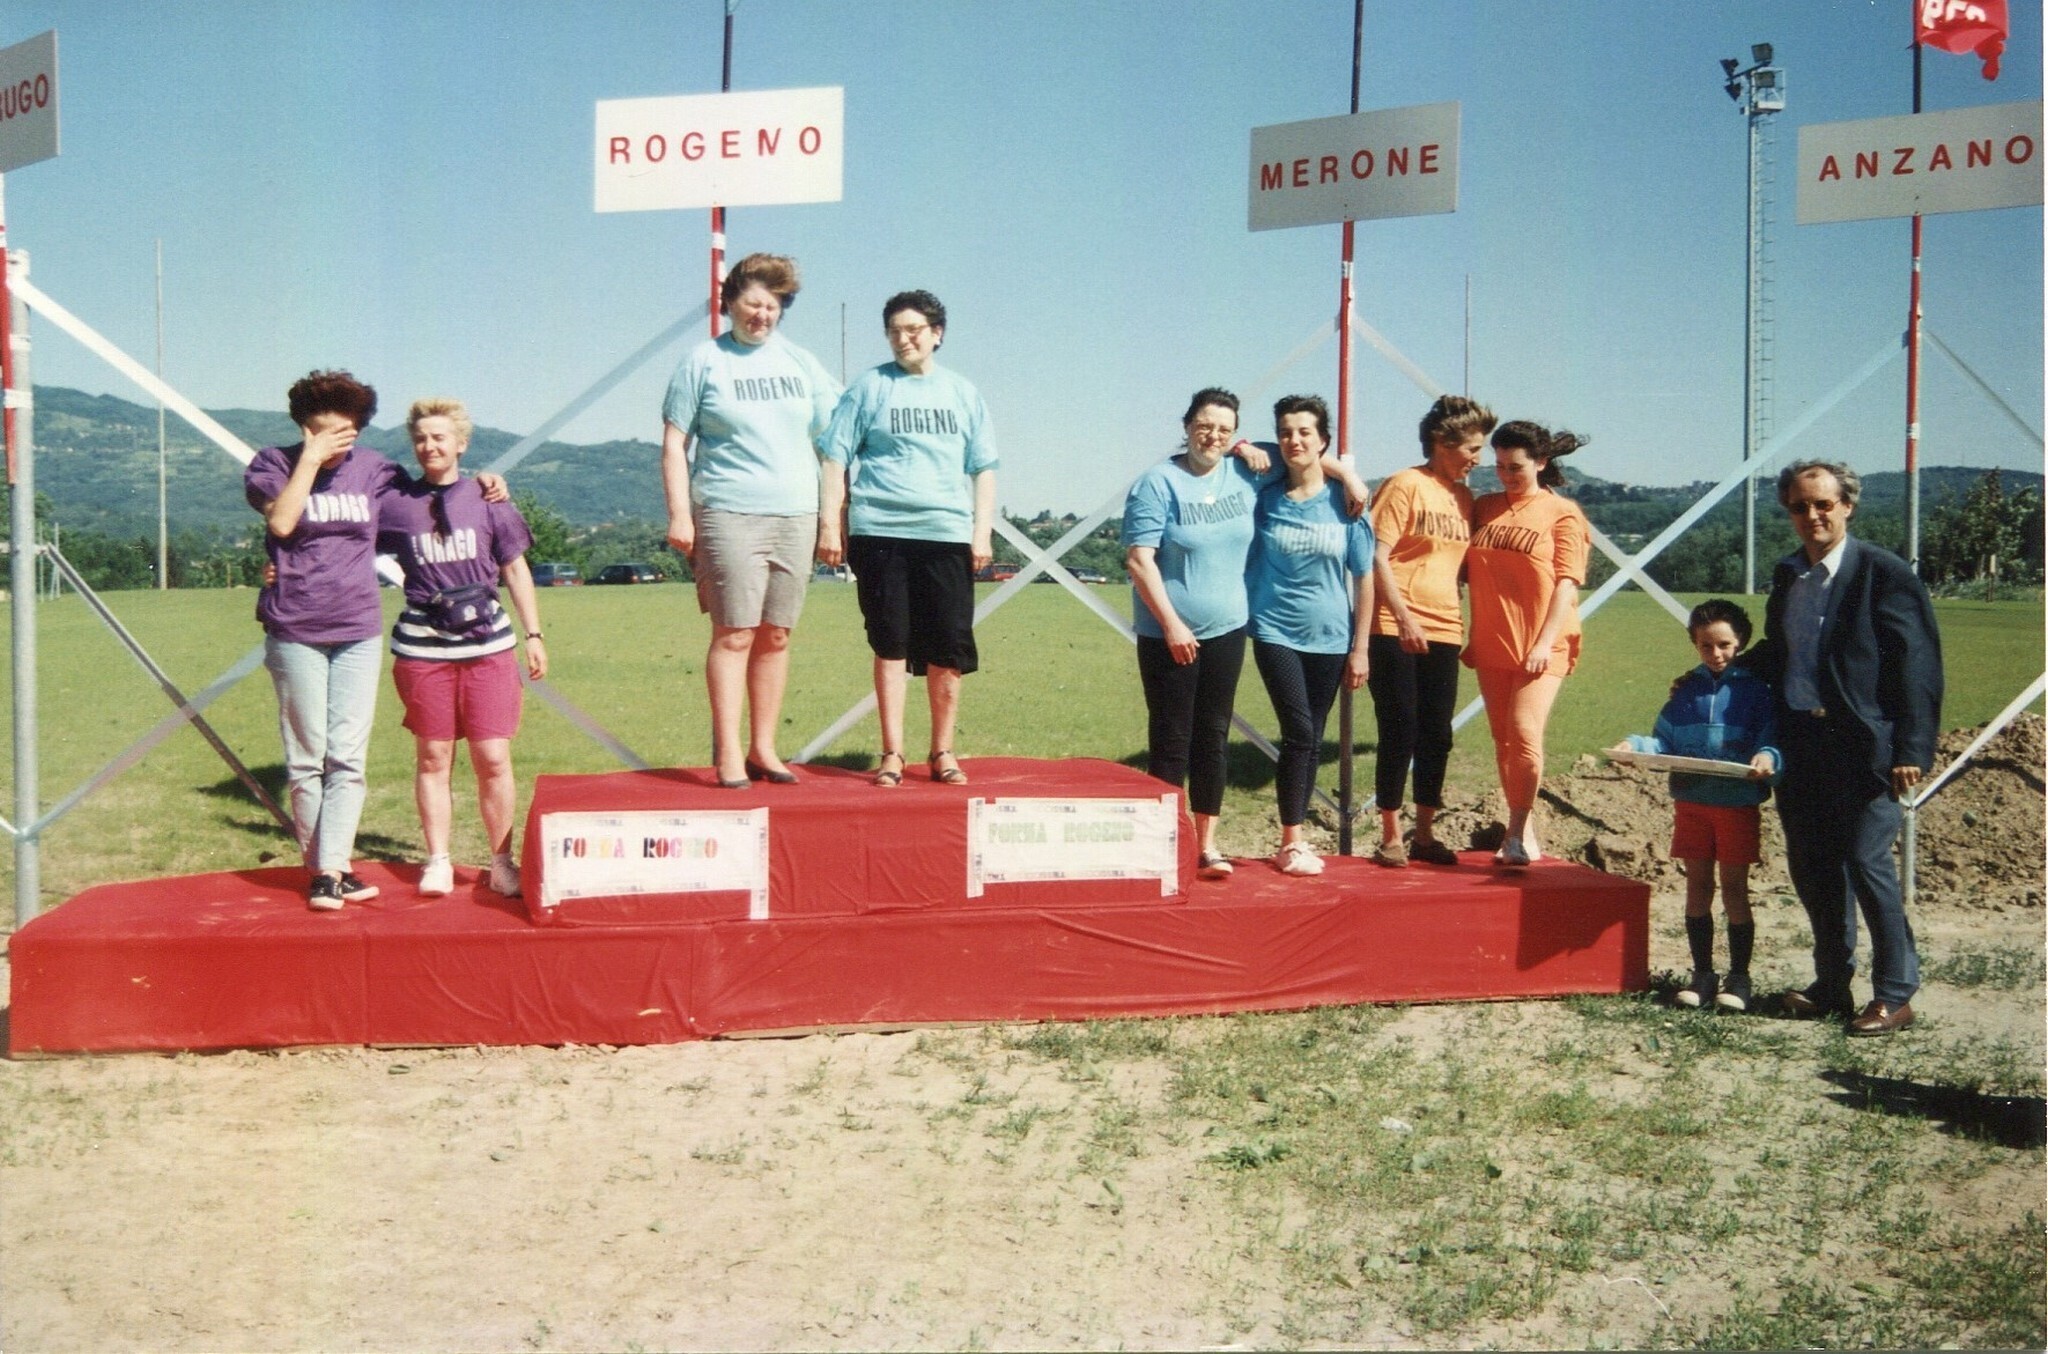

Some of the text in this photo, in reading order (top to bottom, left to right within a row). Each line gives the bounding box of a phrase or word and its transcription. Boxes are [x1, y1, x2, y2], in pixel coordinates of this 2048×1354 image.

[0, 74, 49, 121] UGO
[609, 125, 822, 165] ROGENO
[1818, 134, 2033, 182] ANZANO
[1260, 144, 1440, 191] MERONE
[734, 376, 805, 401] ROGENO
[890, 408, 958, 434] ROGENO
